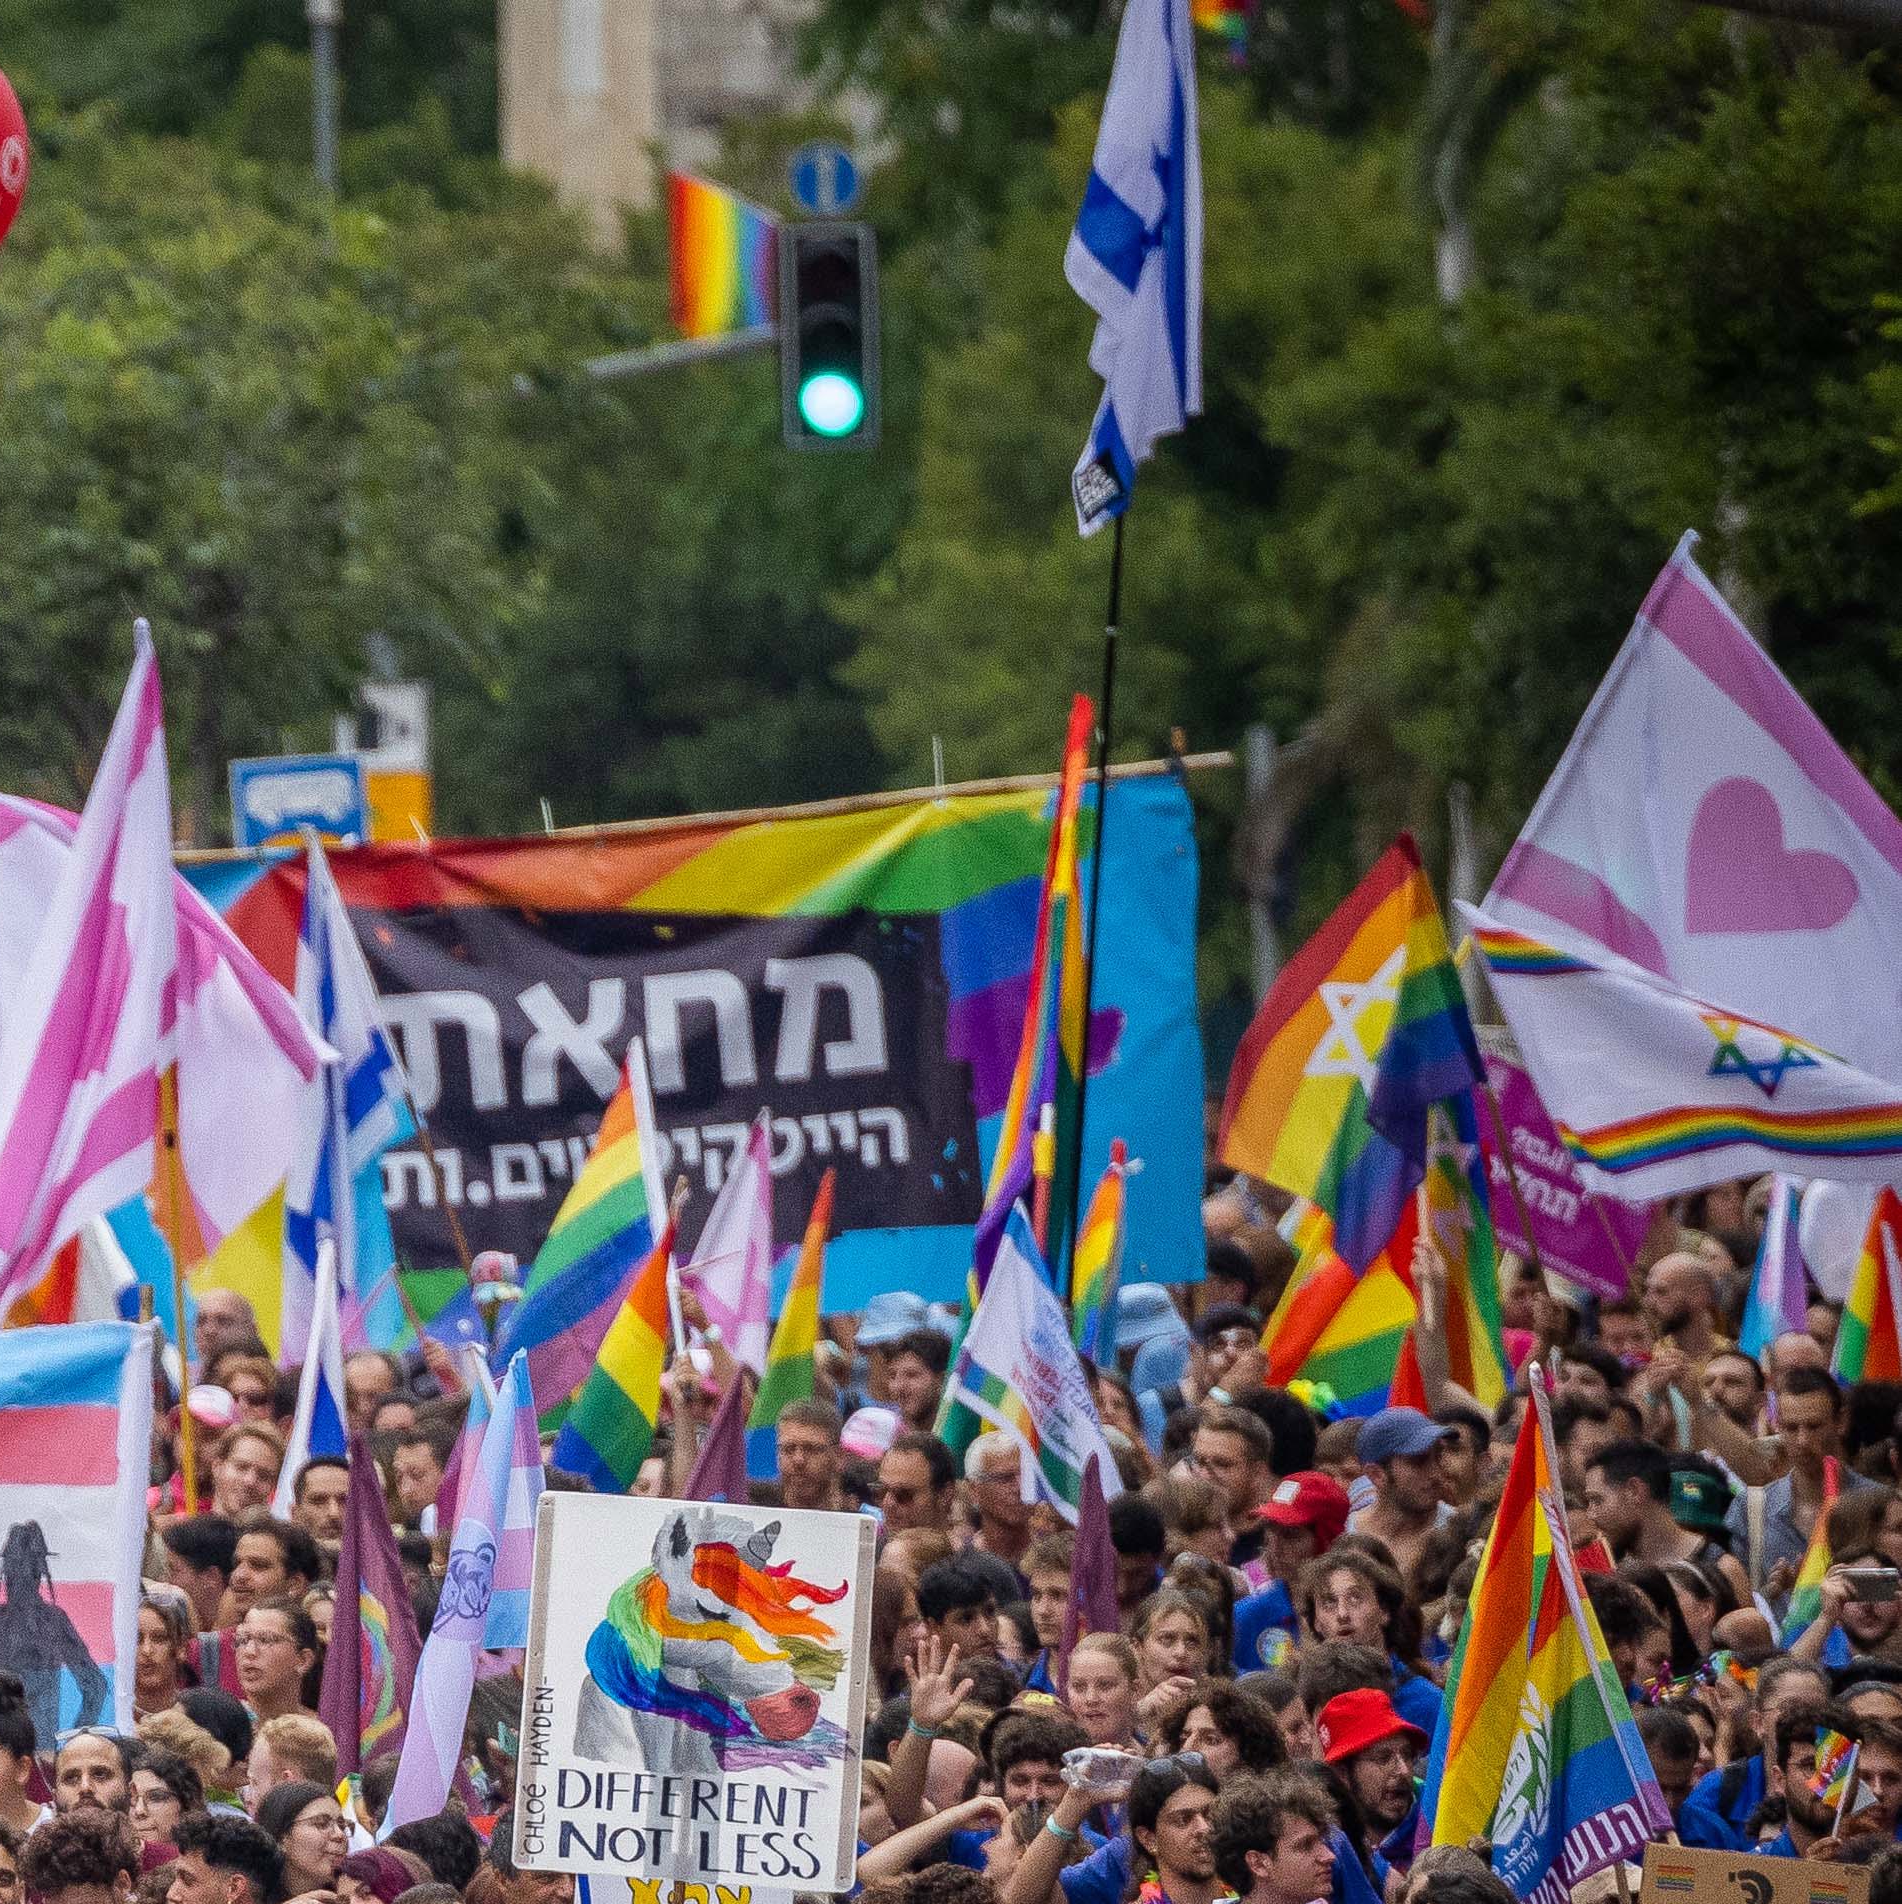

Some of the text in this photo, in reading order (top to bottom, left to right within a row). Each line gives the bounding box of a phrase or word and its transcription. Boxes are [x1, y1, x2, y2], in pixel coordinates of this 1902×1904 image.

[379, 953, 889, 1112] מחאת
[558, 1769, 818, 1828] DIFFERENT
[559, 1822, 821, 1883] NOT LESS
